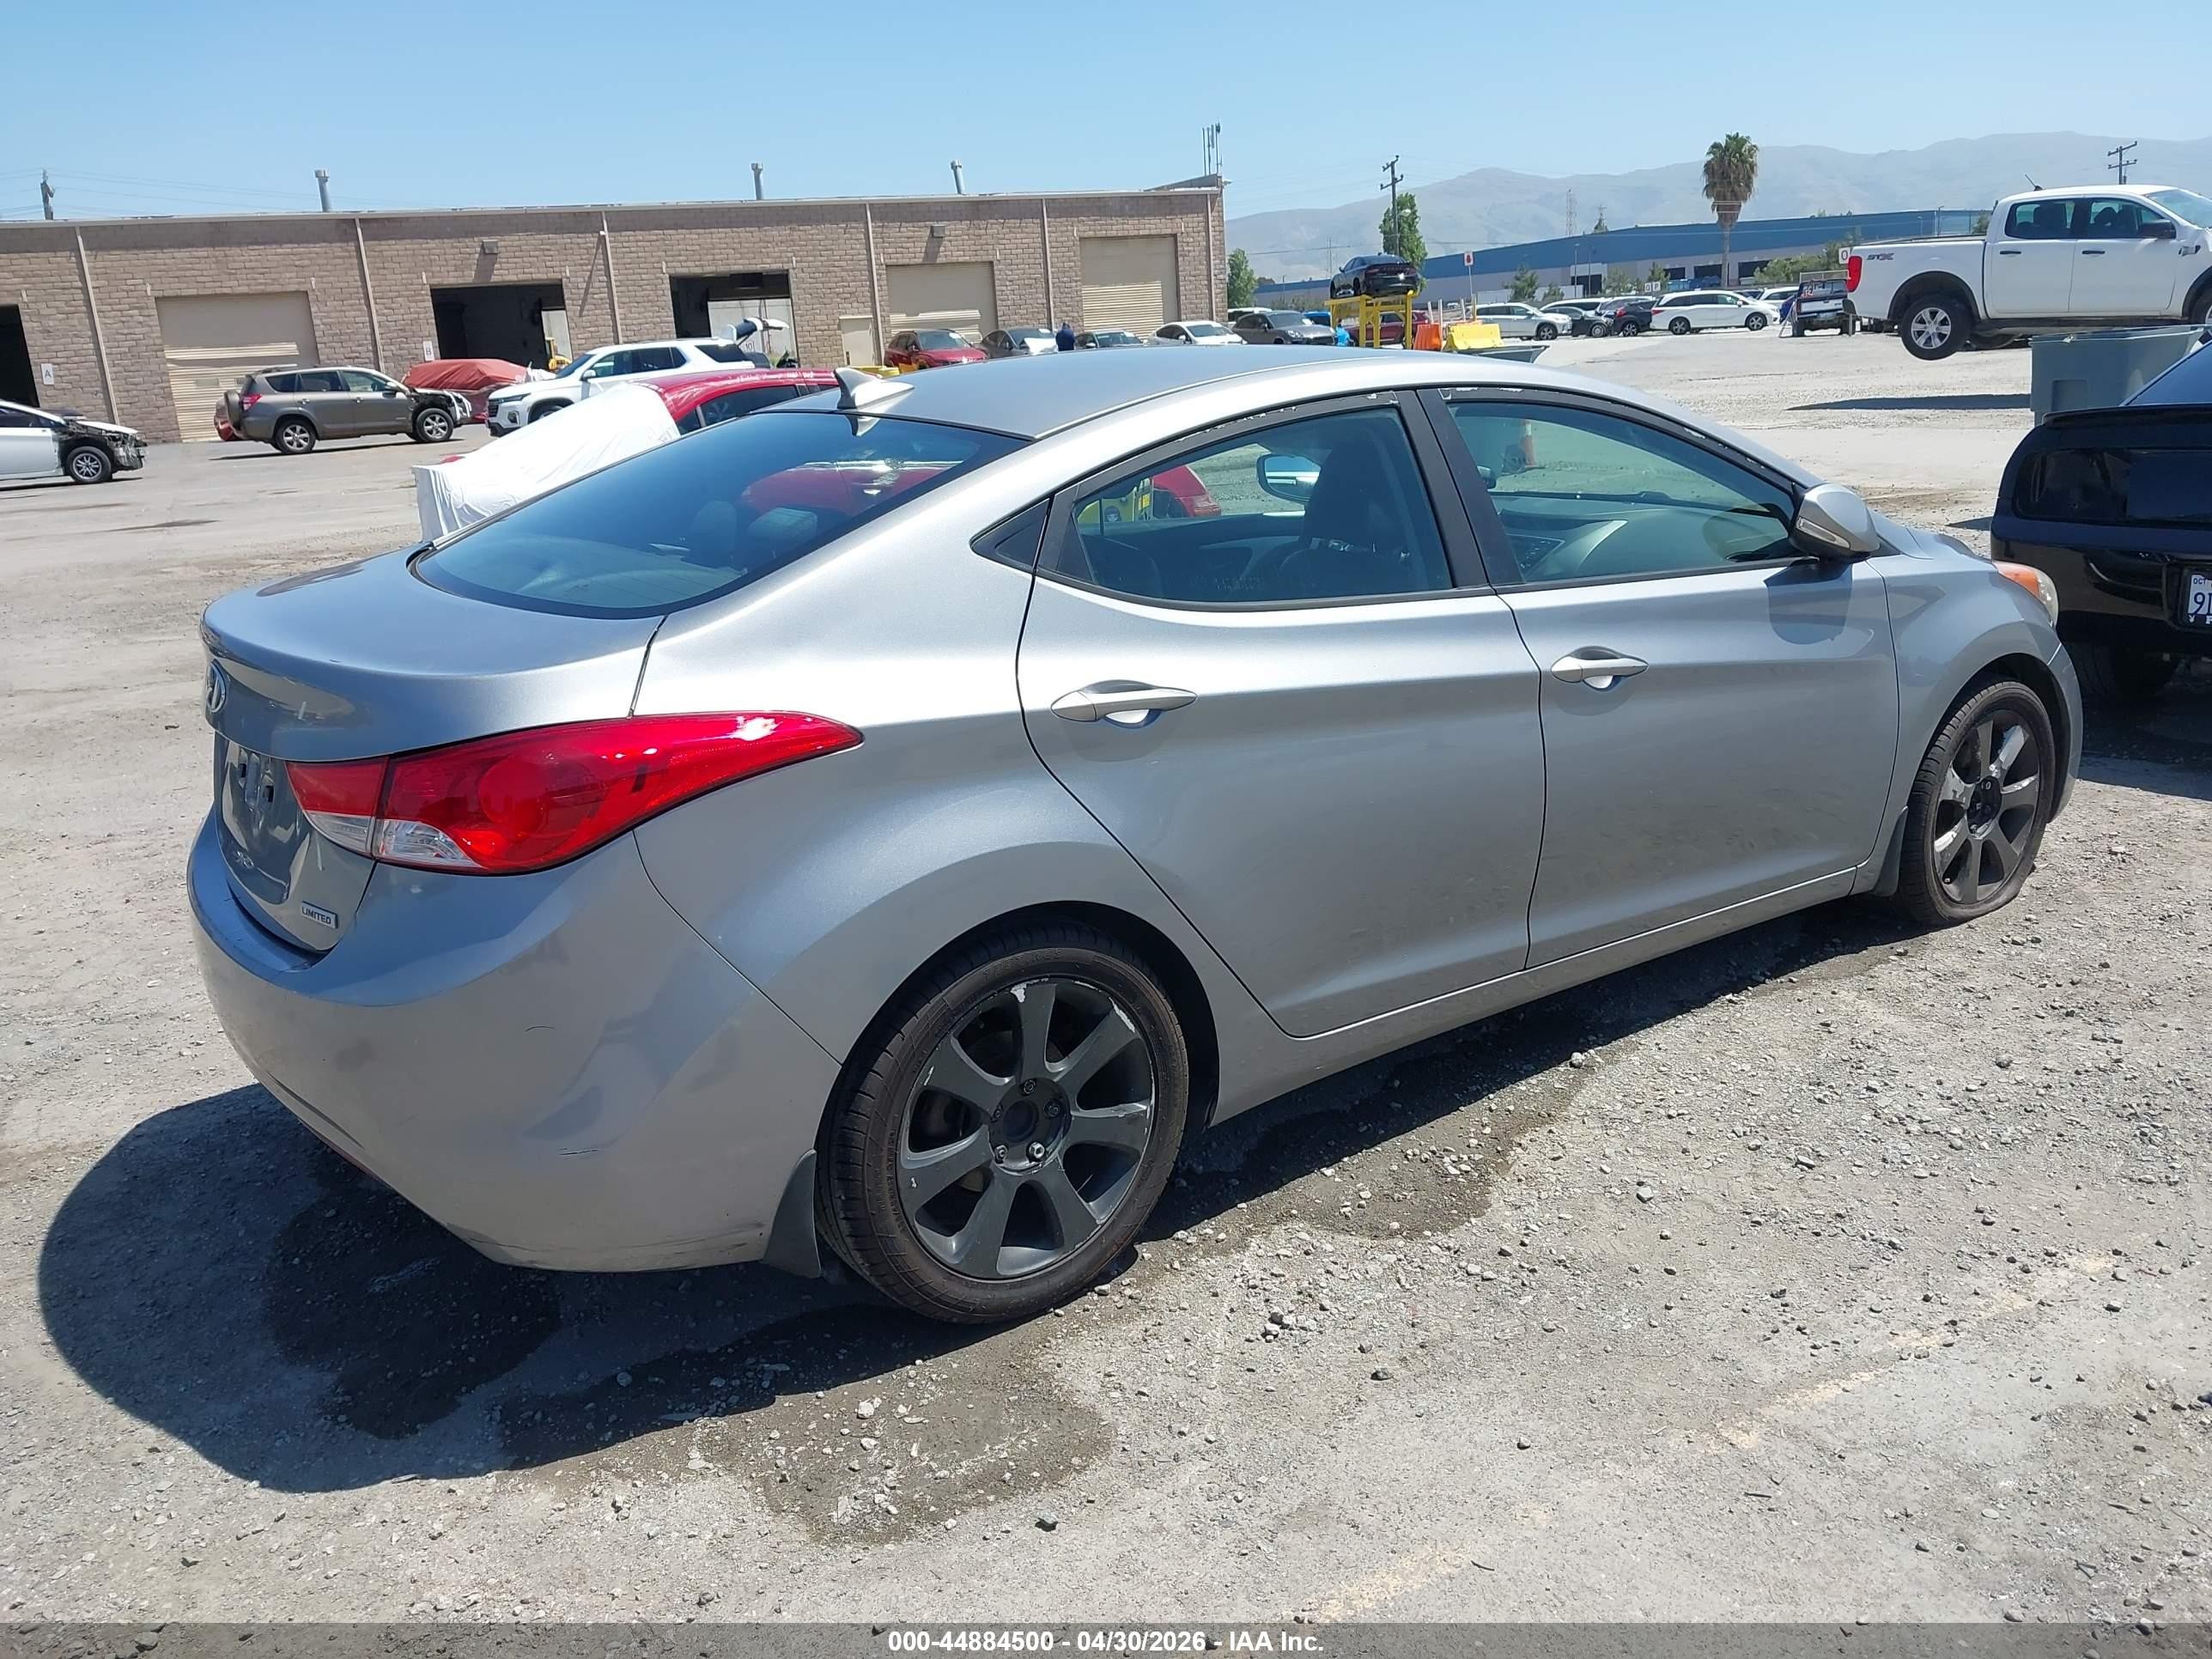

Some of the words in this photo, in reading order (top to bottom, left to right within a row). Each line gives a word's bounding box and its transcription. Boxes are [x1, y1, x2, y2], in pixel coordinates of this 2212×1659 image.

[426, 347, 432, 356] B
[45, 369, 52, 378] A
[302, 906, 331, 925] LIMITED
